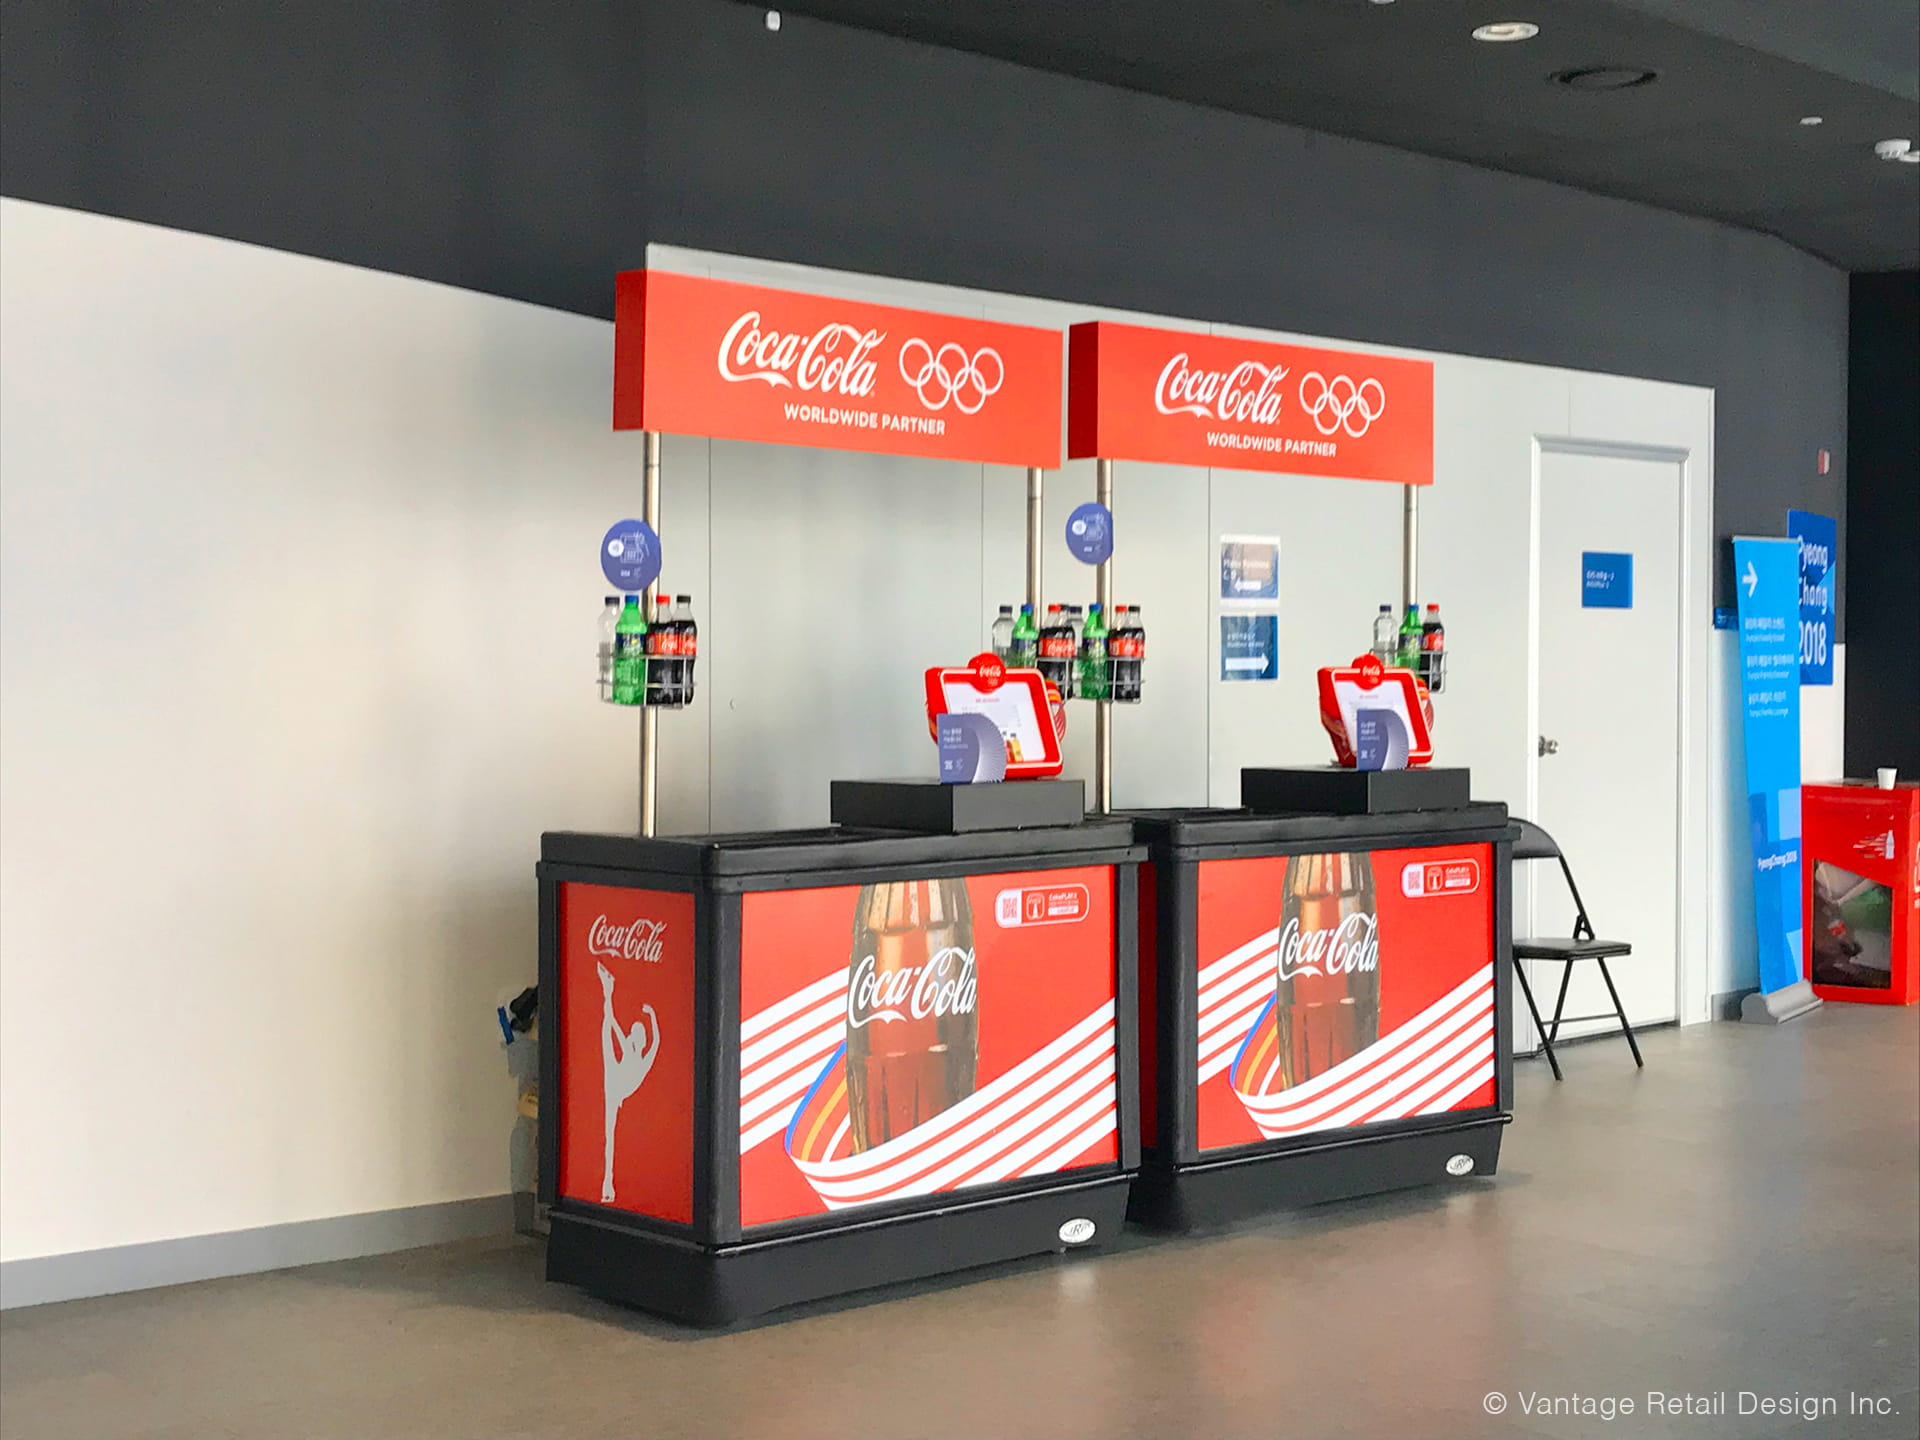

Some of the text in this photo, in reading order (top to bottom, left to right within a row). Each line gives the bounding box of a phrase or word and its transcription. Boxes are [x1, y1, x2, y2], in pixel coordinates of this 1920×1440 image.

[717, 311, 888, 397] Coca-Cola
[1155, 352, 1290, 425] Coca-Cola
[784, 402, 946, 436] WORLDWIDE PARTNER
[1206, 431, 1338, 458] WORLDWIDE PARTNER
[1799, 576, 1828, 615] hang
[588, 914, 667, 963] Coca-Cola
[1279, 912, 1379, 982] Coca-Cola
[848, 947, 977, 1029] Coca-Cola
